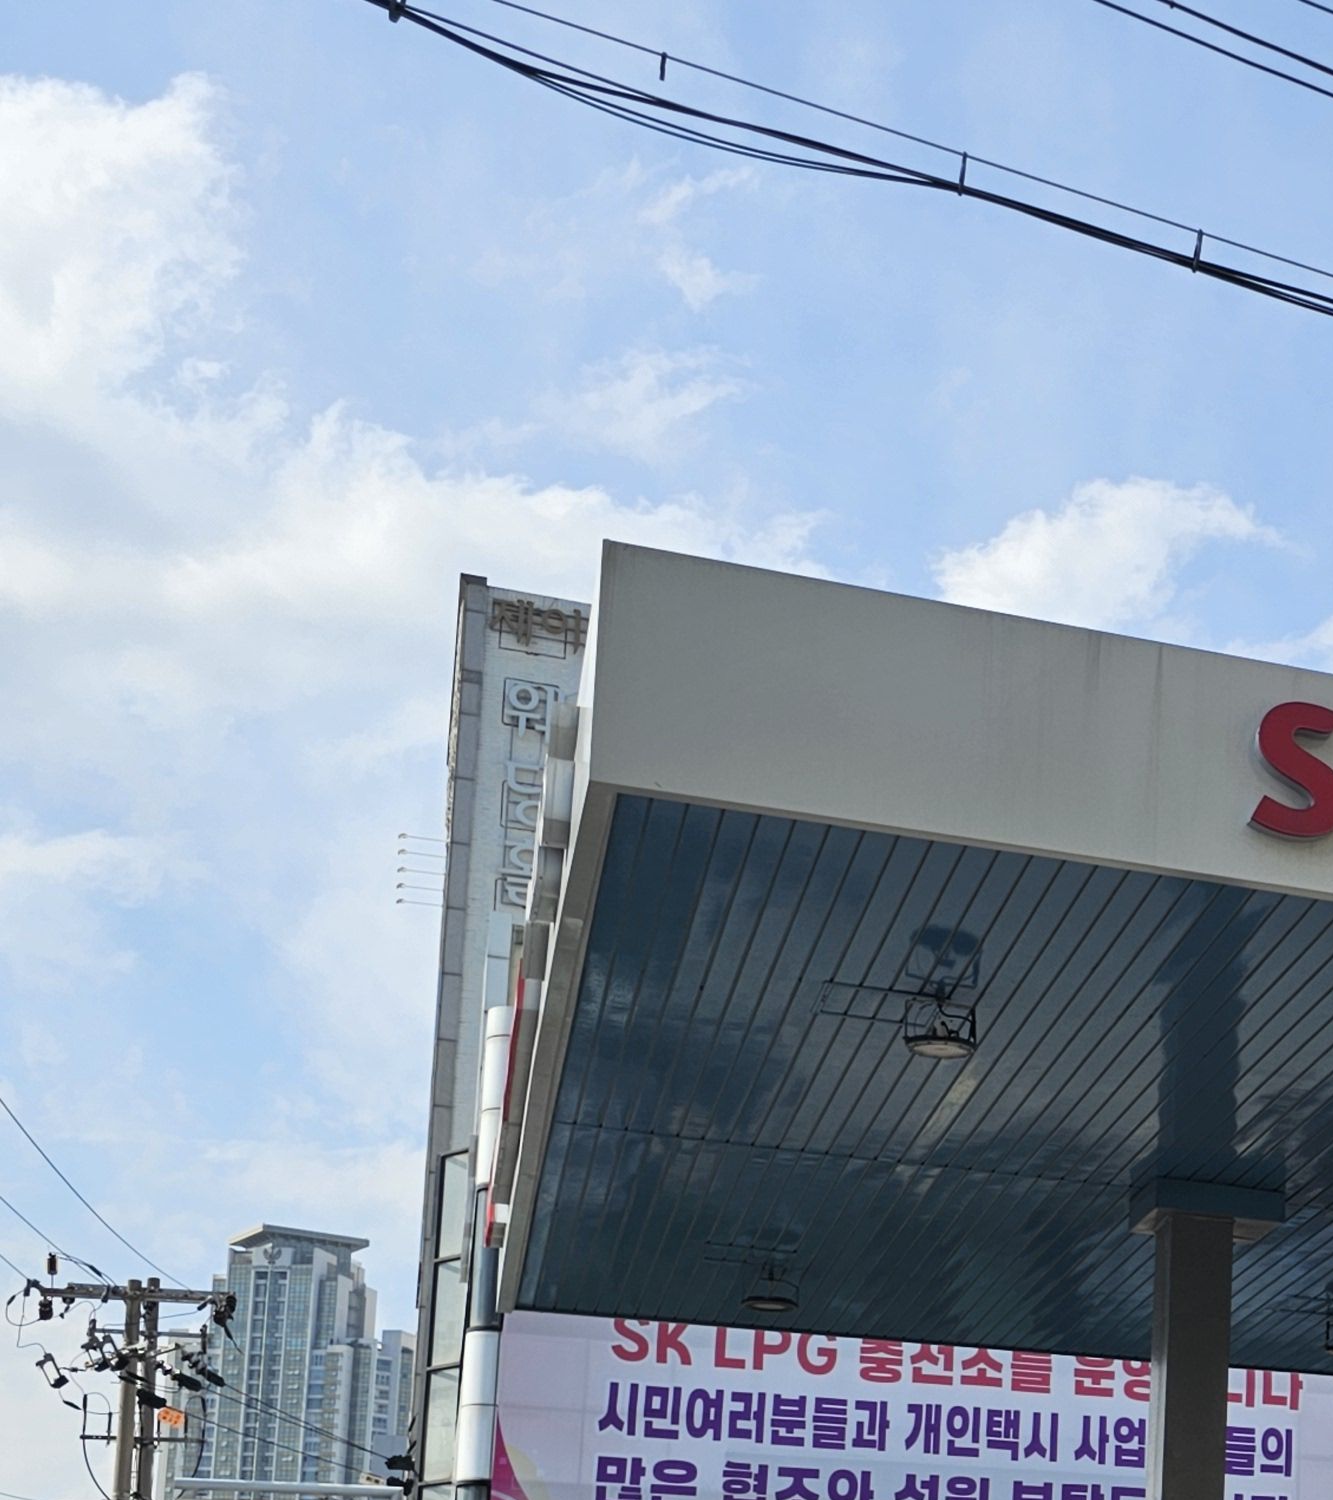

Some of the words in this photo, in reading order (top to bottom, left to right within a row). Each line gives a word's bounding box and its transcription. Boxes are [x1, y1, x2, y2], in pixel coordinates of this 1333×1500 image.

[611, 1318, 692, 1366] SK
[713, 1327, 838, 1375] LPG
[598, 1382, 890, 1451] 시민여러분들과
[905, 1403, 1058, 1462] 개인택시
[1074, 1415, 1292, 1477] 사업들의
